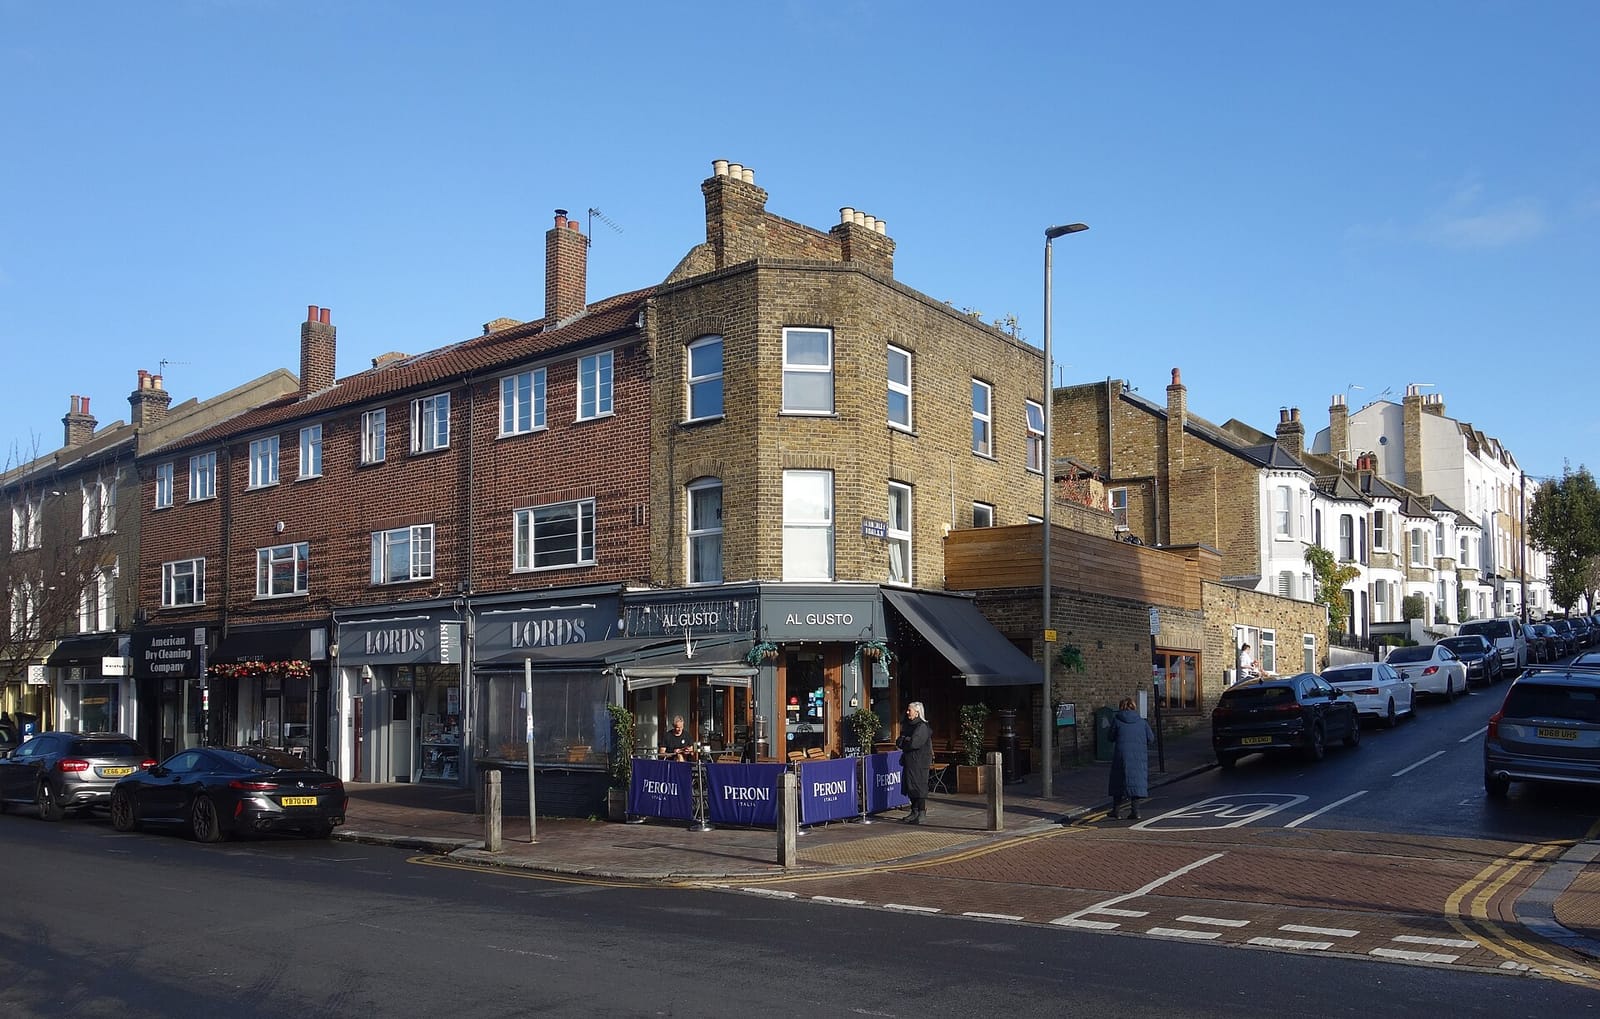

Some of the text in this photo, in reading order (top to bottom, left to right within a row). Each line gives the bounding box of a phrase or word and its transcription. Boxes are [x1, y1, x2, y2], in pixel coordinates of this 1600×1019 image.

[663, 612, 719, 627] AL GUSTO
[786, 613, 853, 625] AL GUSTO
[512, 618, 586, 647] LORDS
[151, 635, 186, 647] American
[366, 628, 425, 655] LORDS
[440, 624, 449, 664] LORDS
[145, 649, 191, 661] Dry Cleaning
[150, 662, 184, 673] Company
[25, 723, 31, 732] P
[1538, 728, 1577, 738] ND68 UHS
[876, 771, 901, 787] PERONI
[642, 779, 678, 796] PERONI
[723, 785, 770, 801] PERONI
[813, 780, 846, 797] PERONI
[1165, 803, 1279, 818] 20
